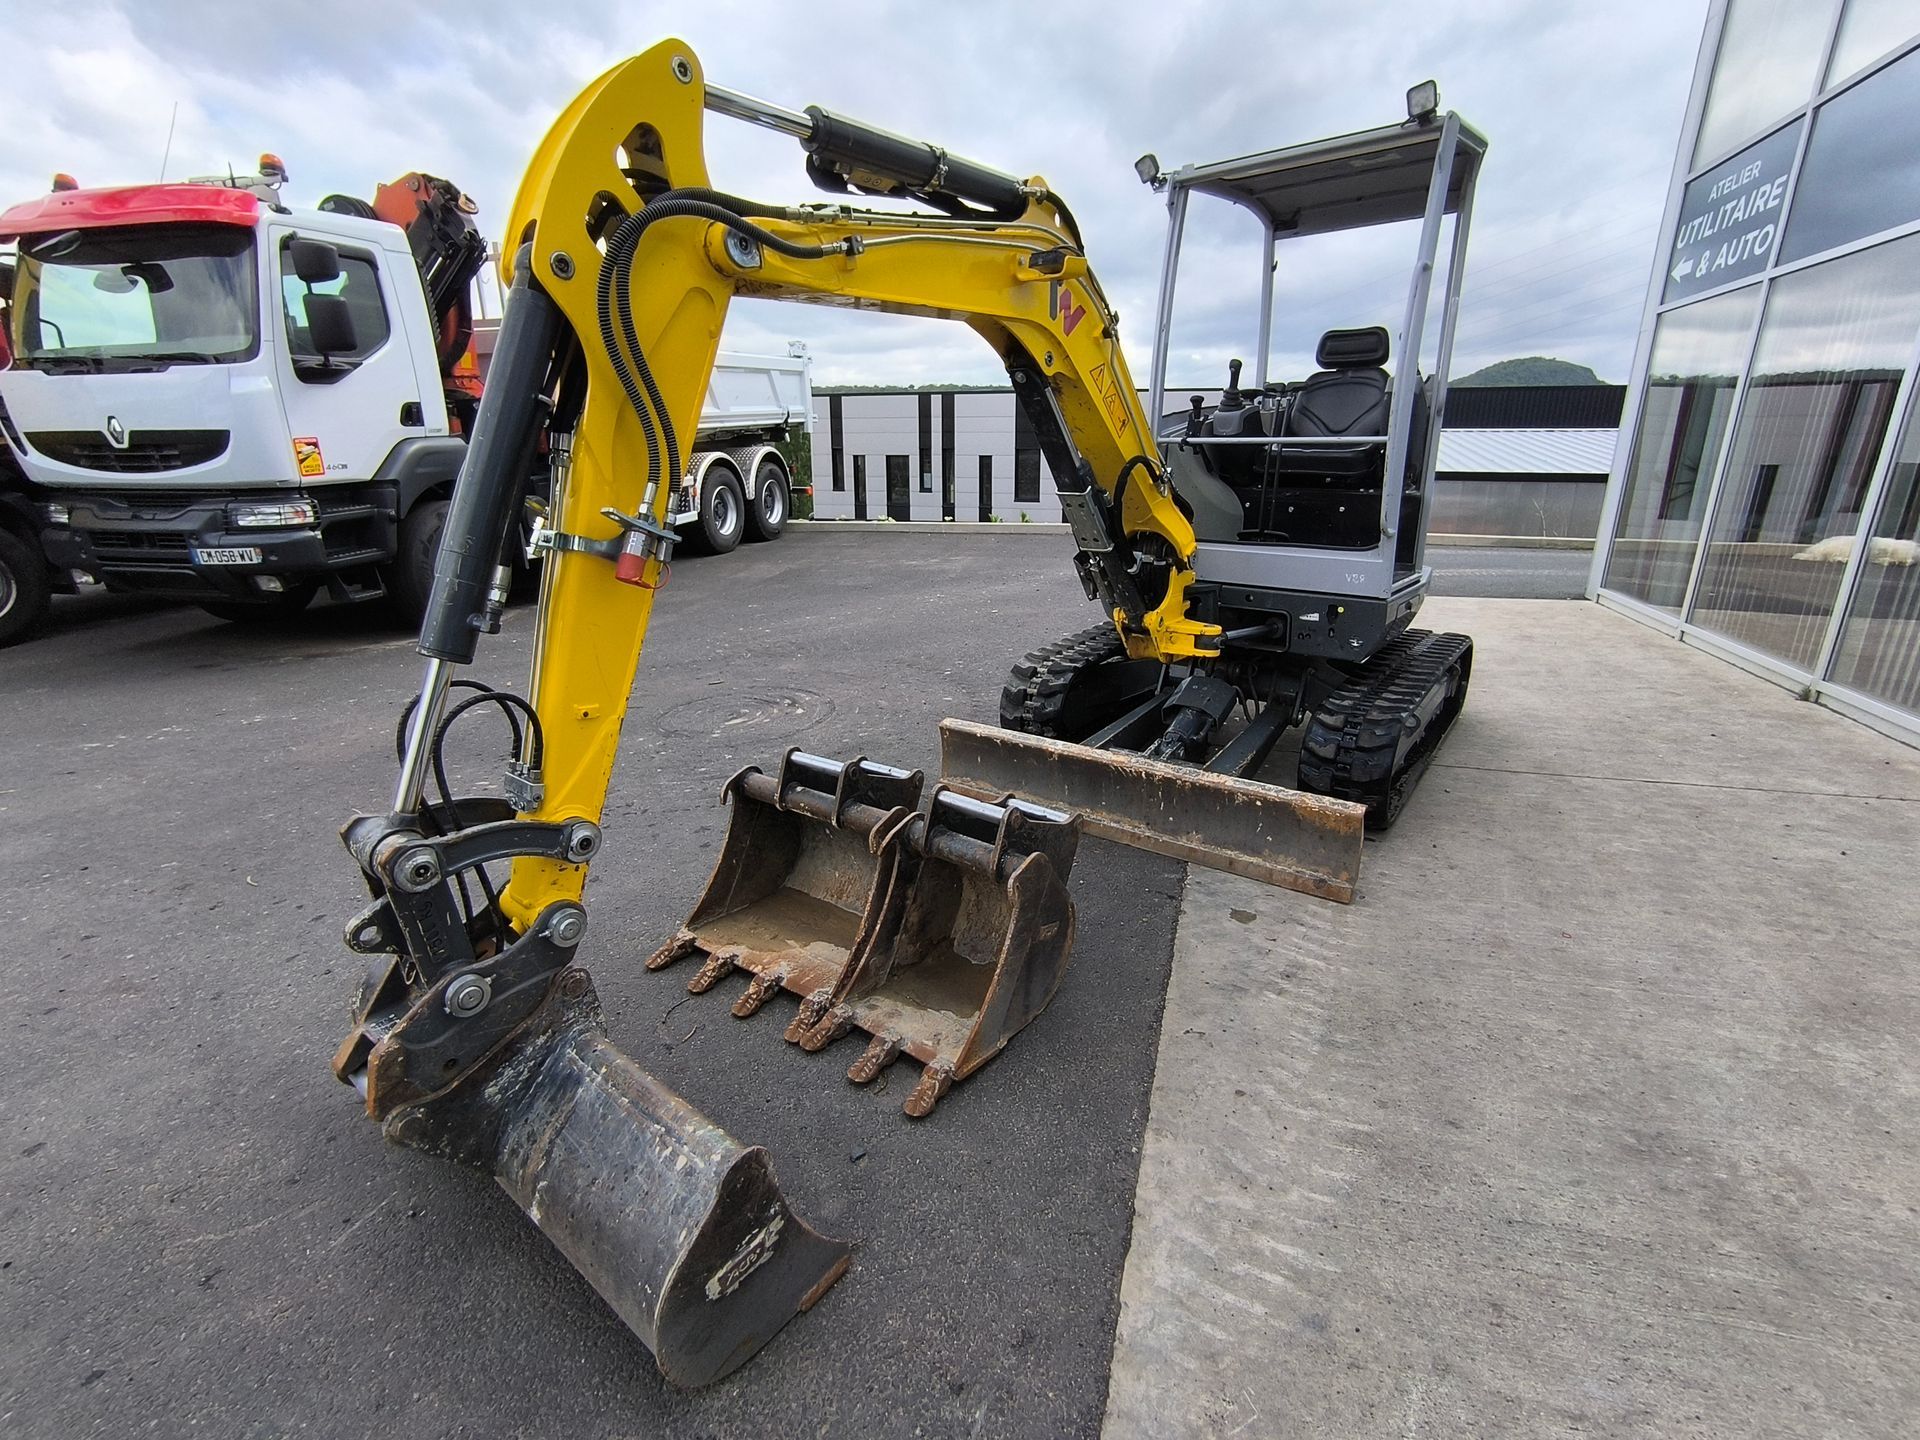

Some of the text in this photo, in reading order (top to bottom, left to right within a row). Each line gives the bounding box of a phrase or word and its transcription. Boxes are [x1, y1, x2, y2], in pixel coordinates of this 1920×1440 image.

[1708, 160, 1762, 202] ATELIER
[1677, 174, 1788, 249] UTILITAIRE
[1695, 223, 1775, 278] & AUTO
[200, 549, 254, 563] CM-058-WV
